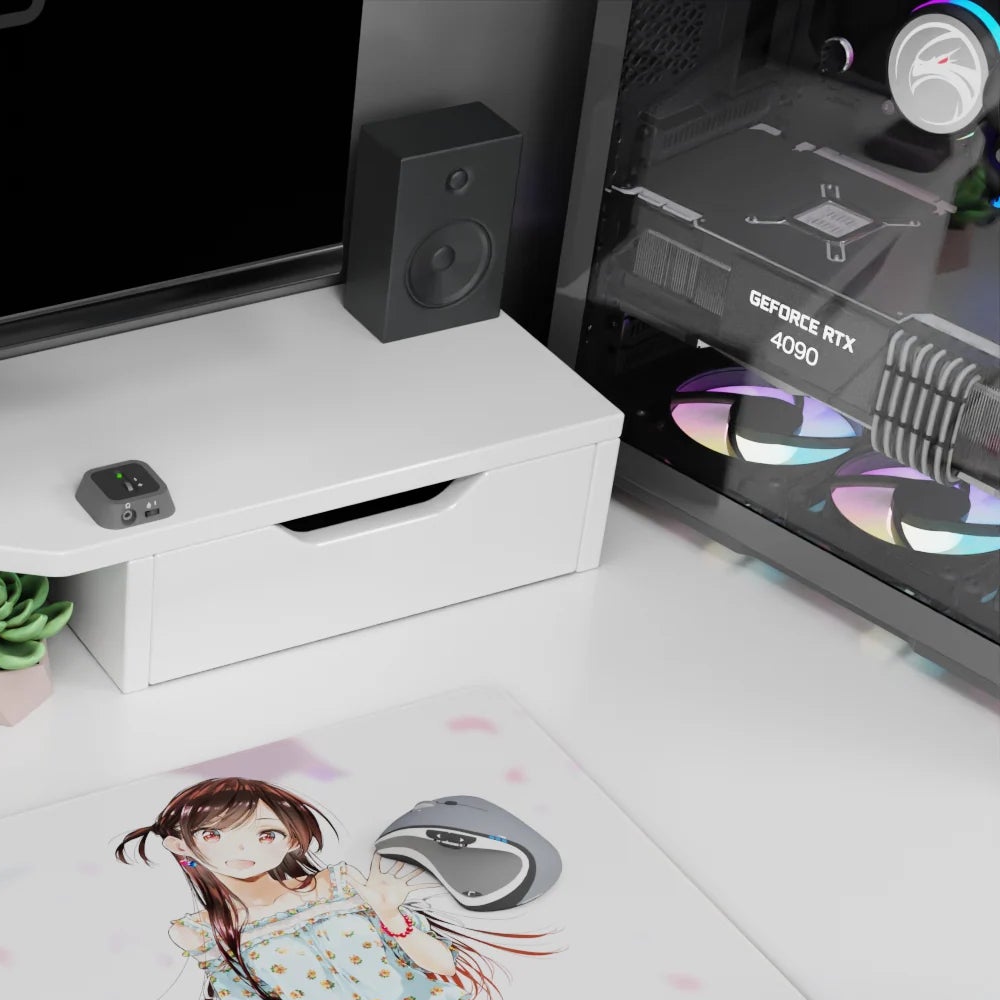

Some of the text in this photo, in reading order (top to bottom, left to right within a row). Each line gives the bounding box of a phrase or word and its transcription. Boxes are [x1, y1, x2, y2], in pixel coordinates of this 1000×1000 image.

[749, 289, 857, 354] GEFORCE RTX
[769, 331, 819, 367] 4090
